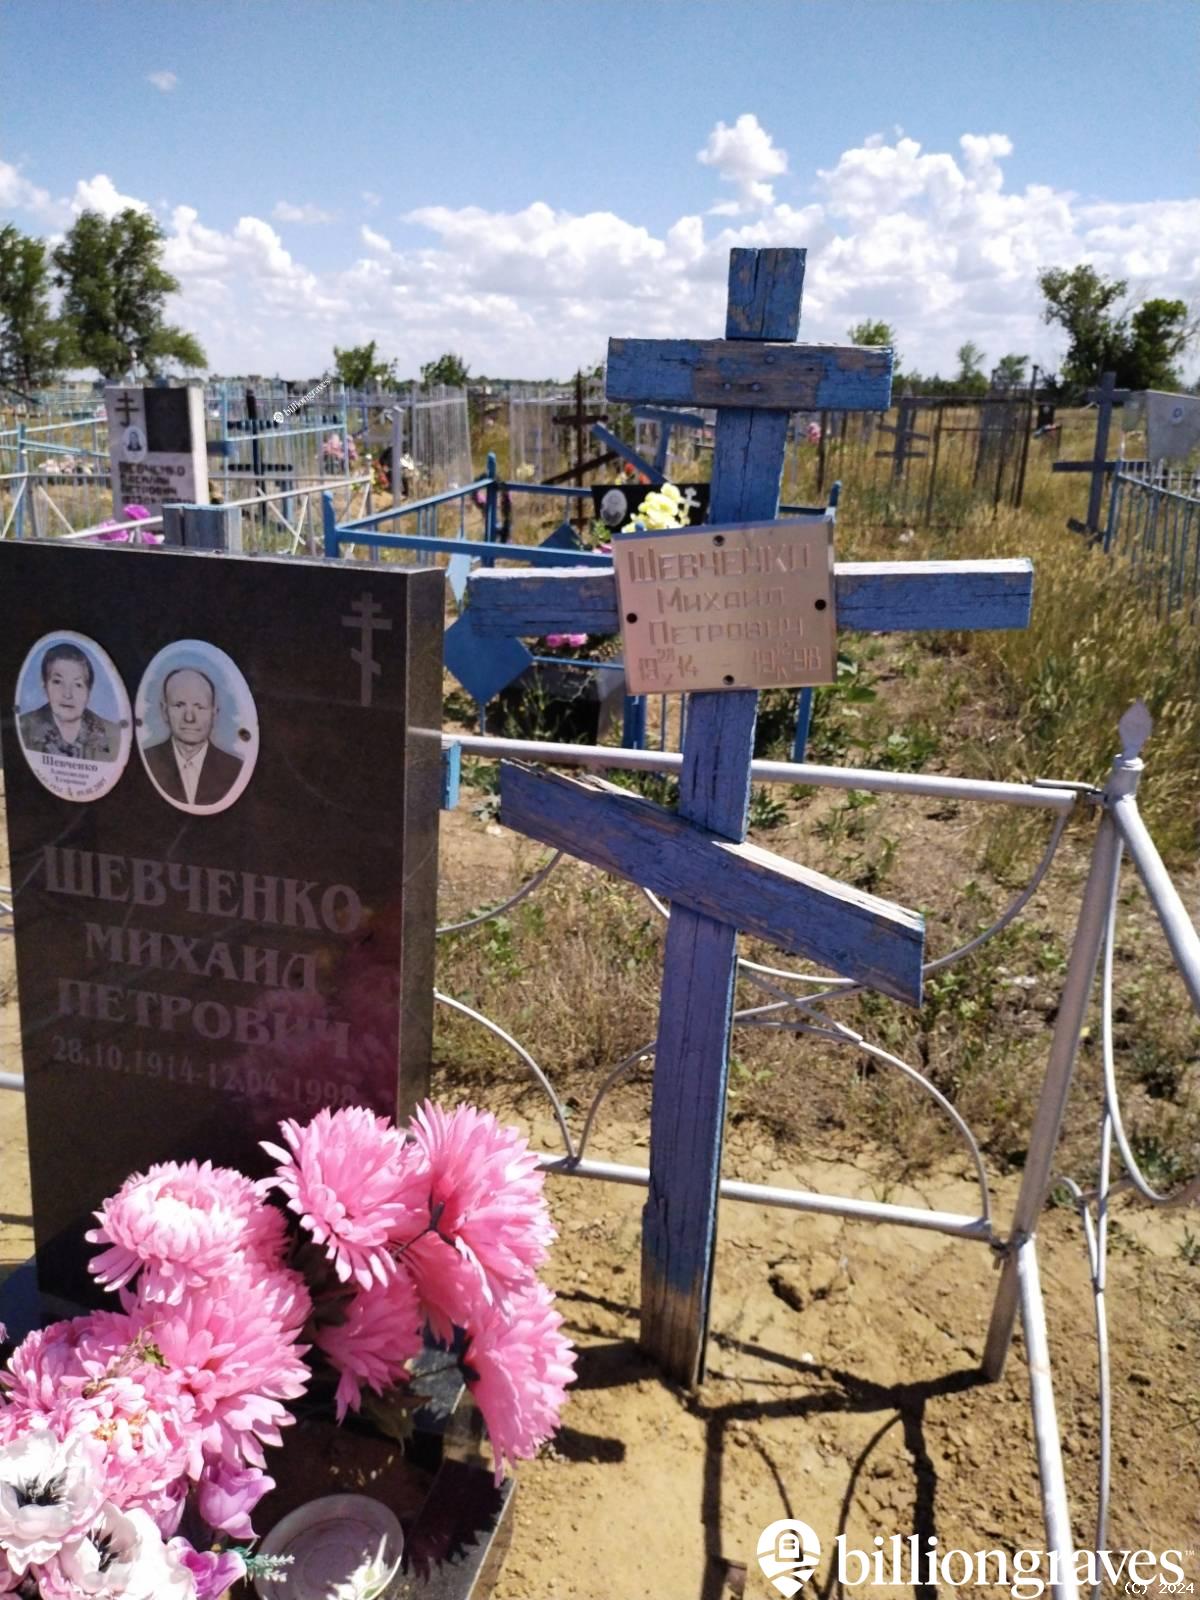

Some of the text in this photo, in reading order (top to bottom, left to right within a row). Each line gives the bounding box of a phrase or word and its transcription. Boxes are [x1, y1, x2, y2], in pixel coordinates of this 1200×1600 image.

[44, 845, 363, 935] ШЕВЧЕНКО
[85, 922, 320, 995] МИХАИЛ
[56, 977, 352, 1060] ПЕТРОВИЧ
